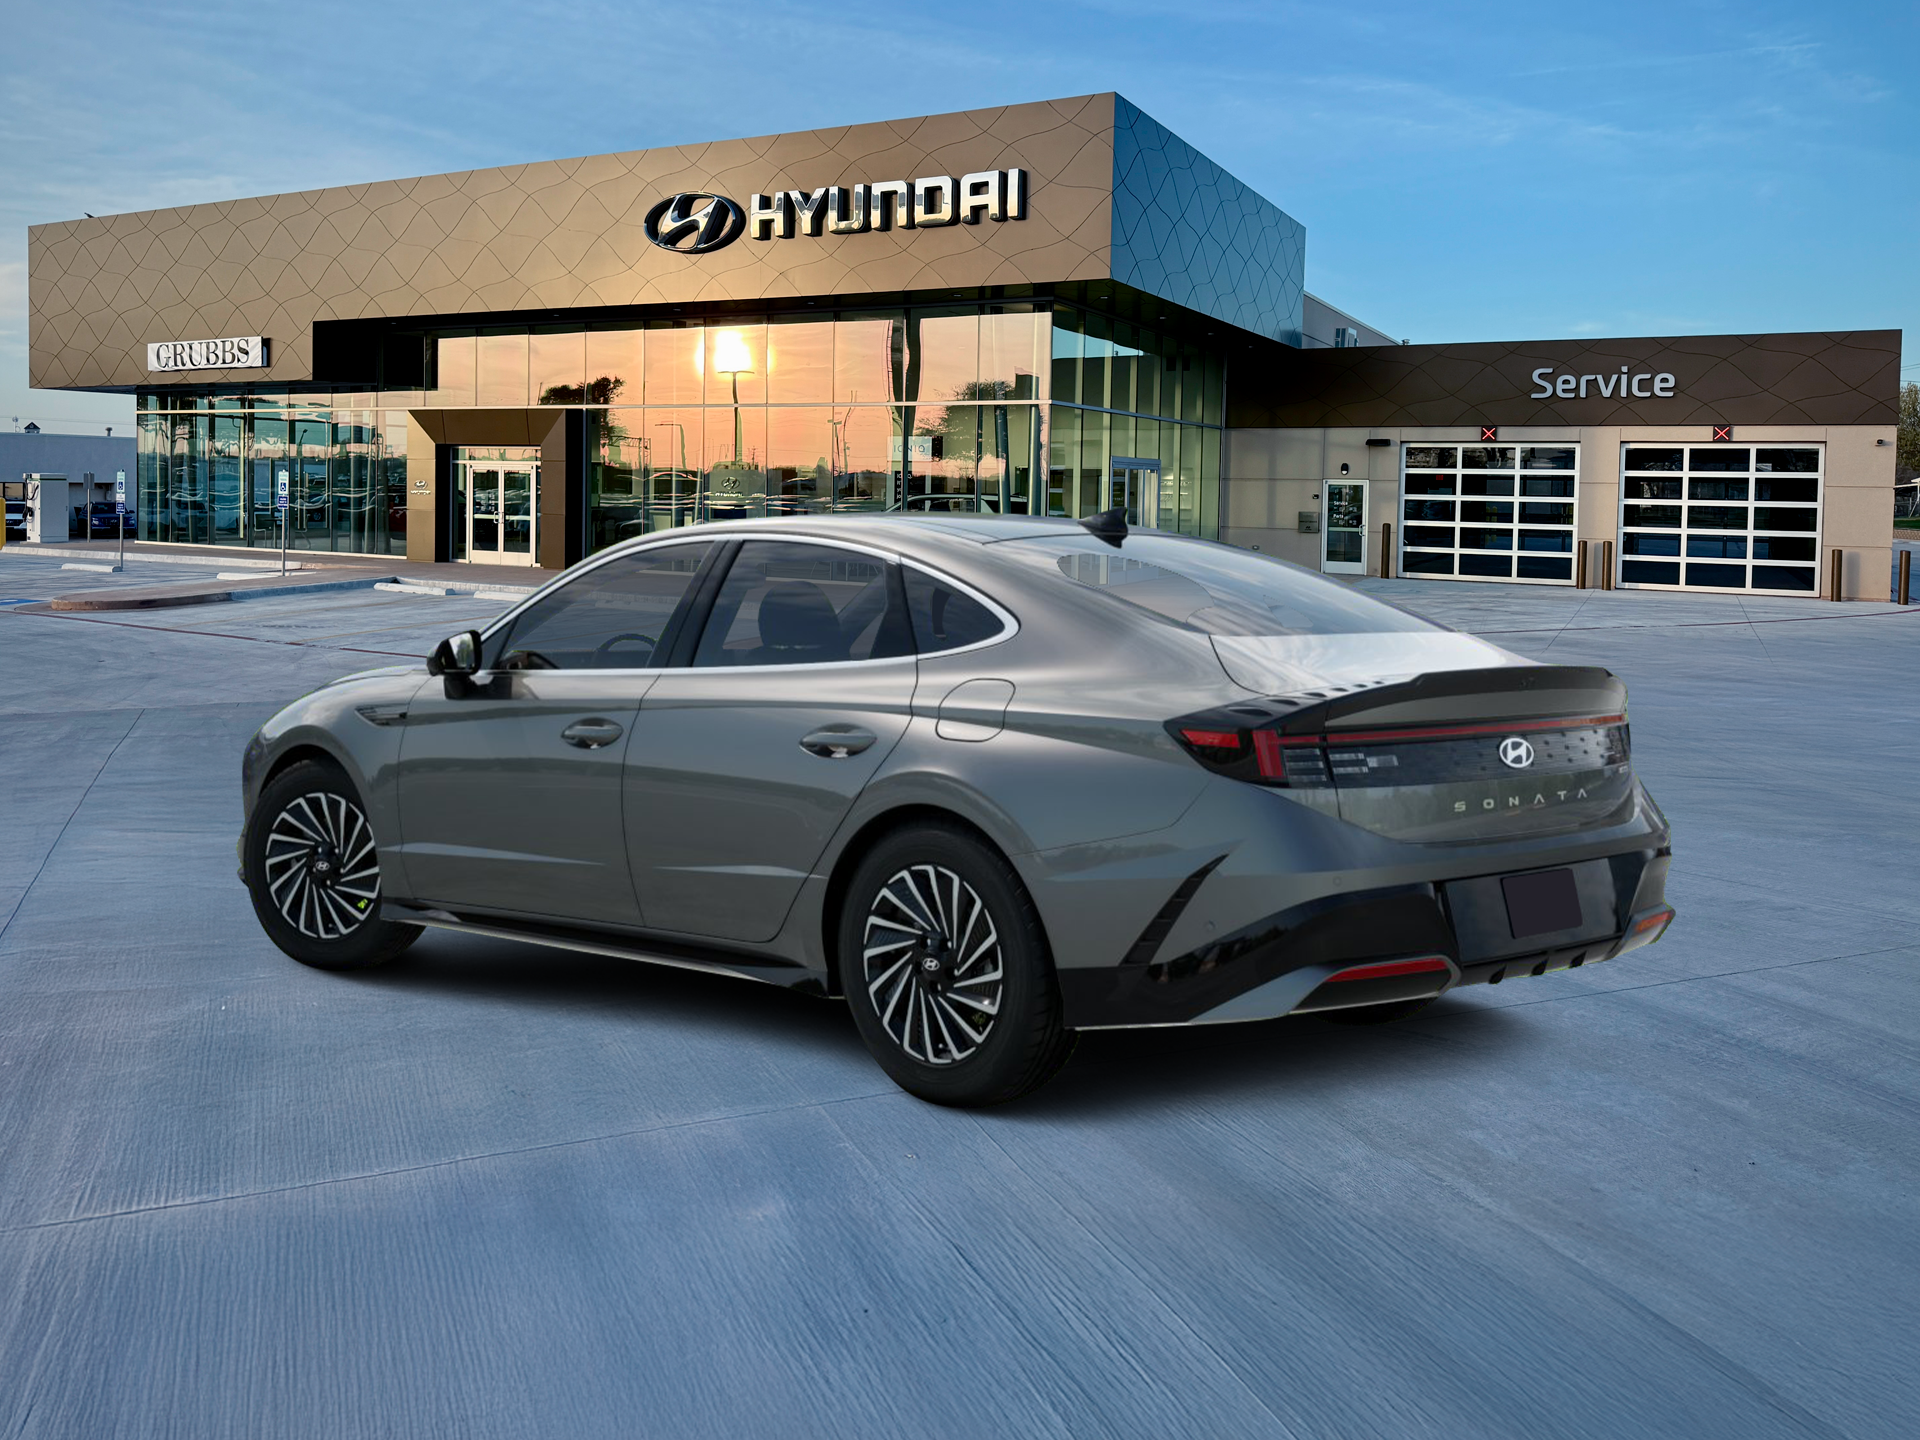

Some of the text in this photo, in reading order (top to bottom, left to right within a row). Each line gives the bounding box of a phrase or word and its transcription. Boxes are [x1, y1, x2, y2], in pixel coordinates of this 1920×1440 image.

[751, 168, 1025, 240] HYUNDAI
[156, 338, 250, 368] GRUBBS
[1530, 365, 1676, 399] Service
[1454, 788, 1588, 812] SONATA
